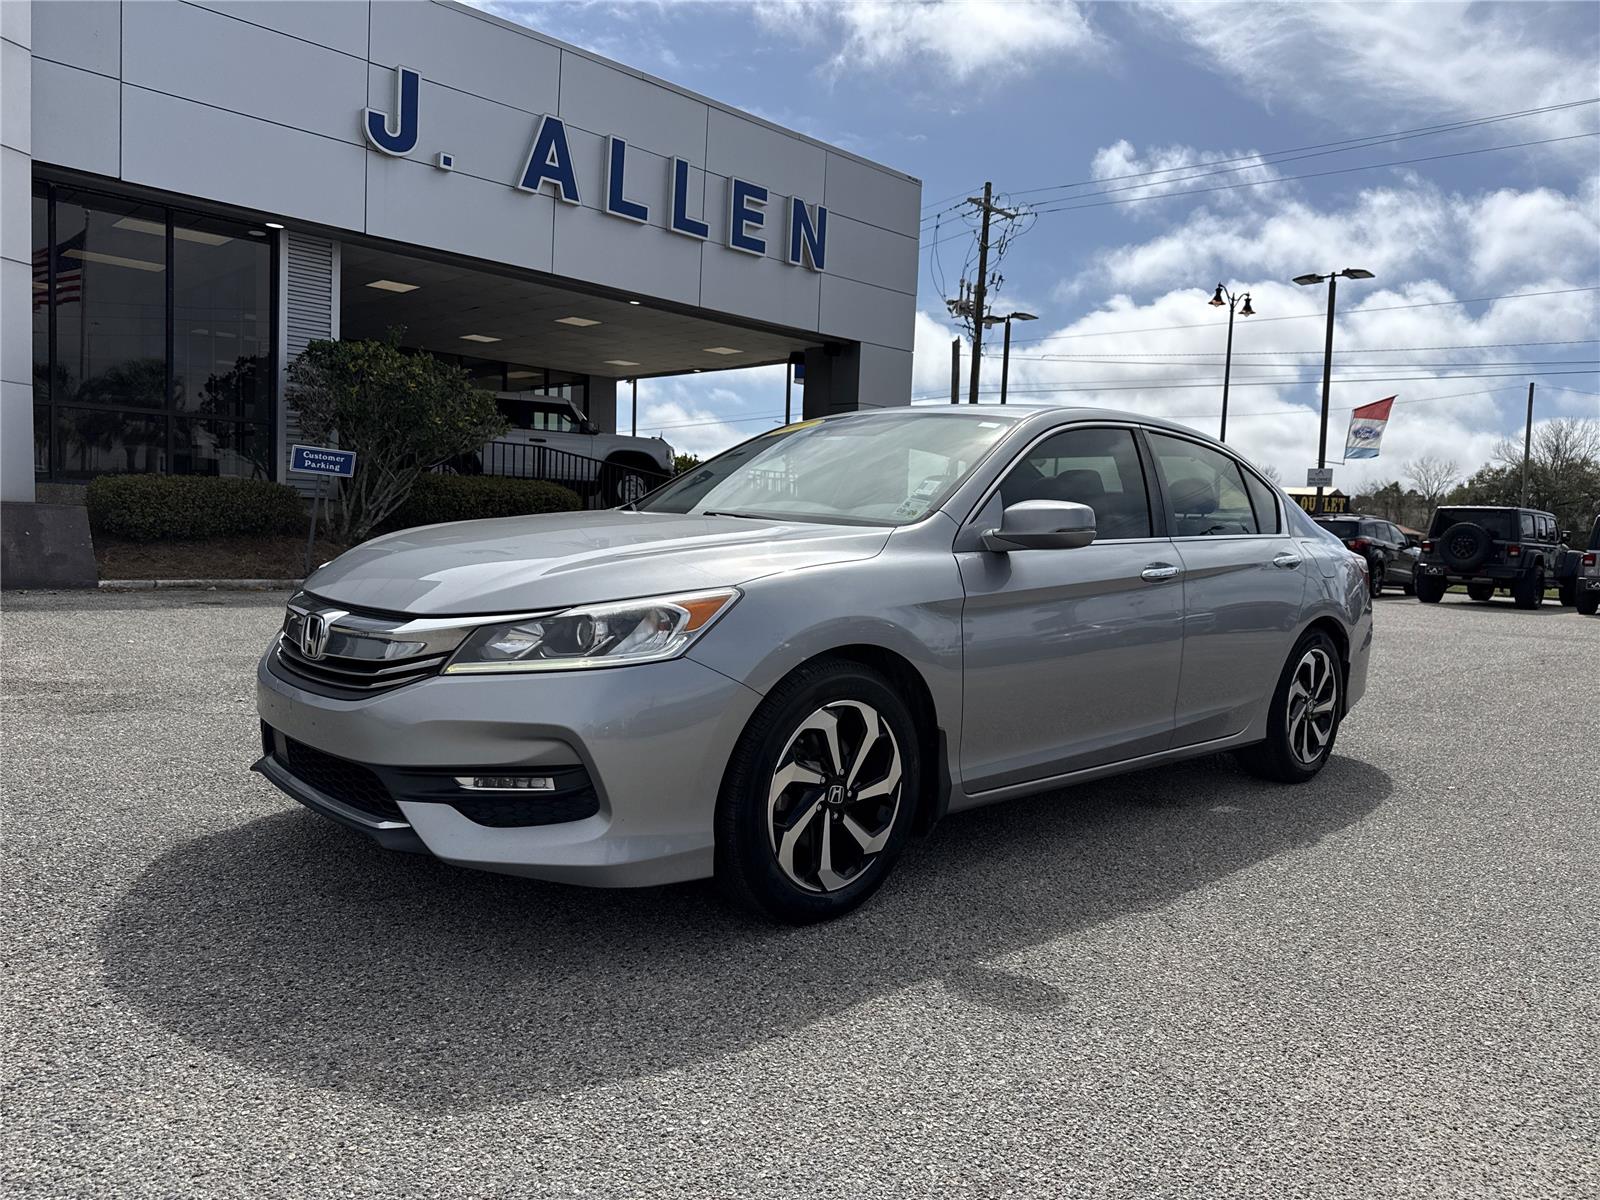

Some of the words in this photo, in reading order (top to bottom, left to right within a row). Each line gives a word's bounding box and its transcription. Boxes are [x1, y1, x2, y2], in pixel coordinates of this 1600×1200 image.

[362, 64, 455, 171] J.
[515, 113, 829, 272] ALLEN
[303, 451, 345, 462] Customer
[304, 460, 341, 471] Parking
[1300, 496, 1346, 512] OULET
